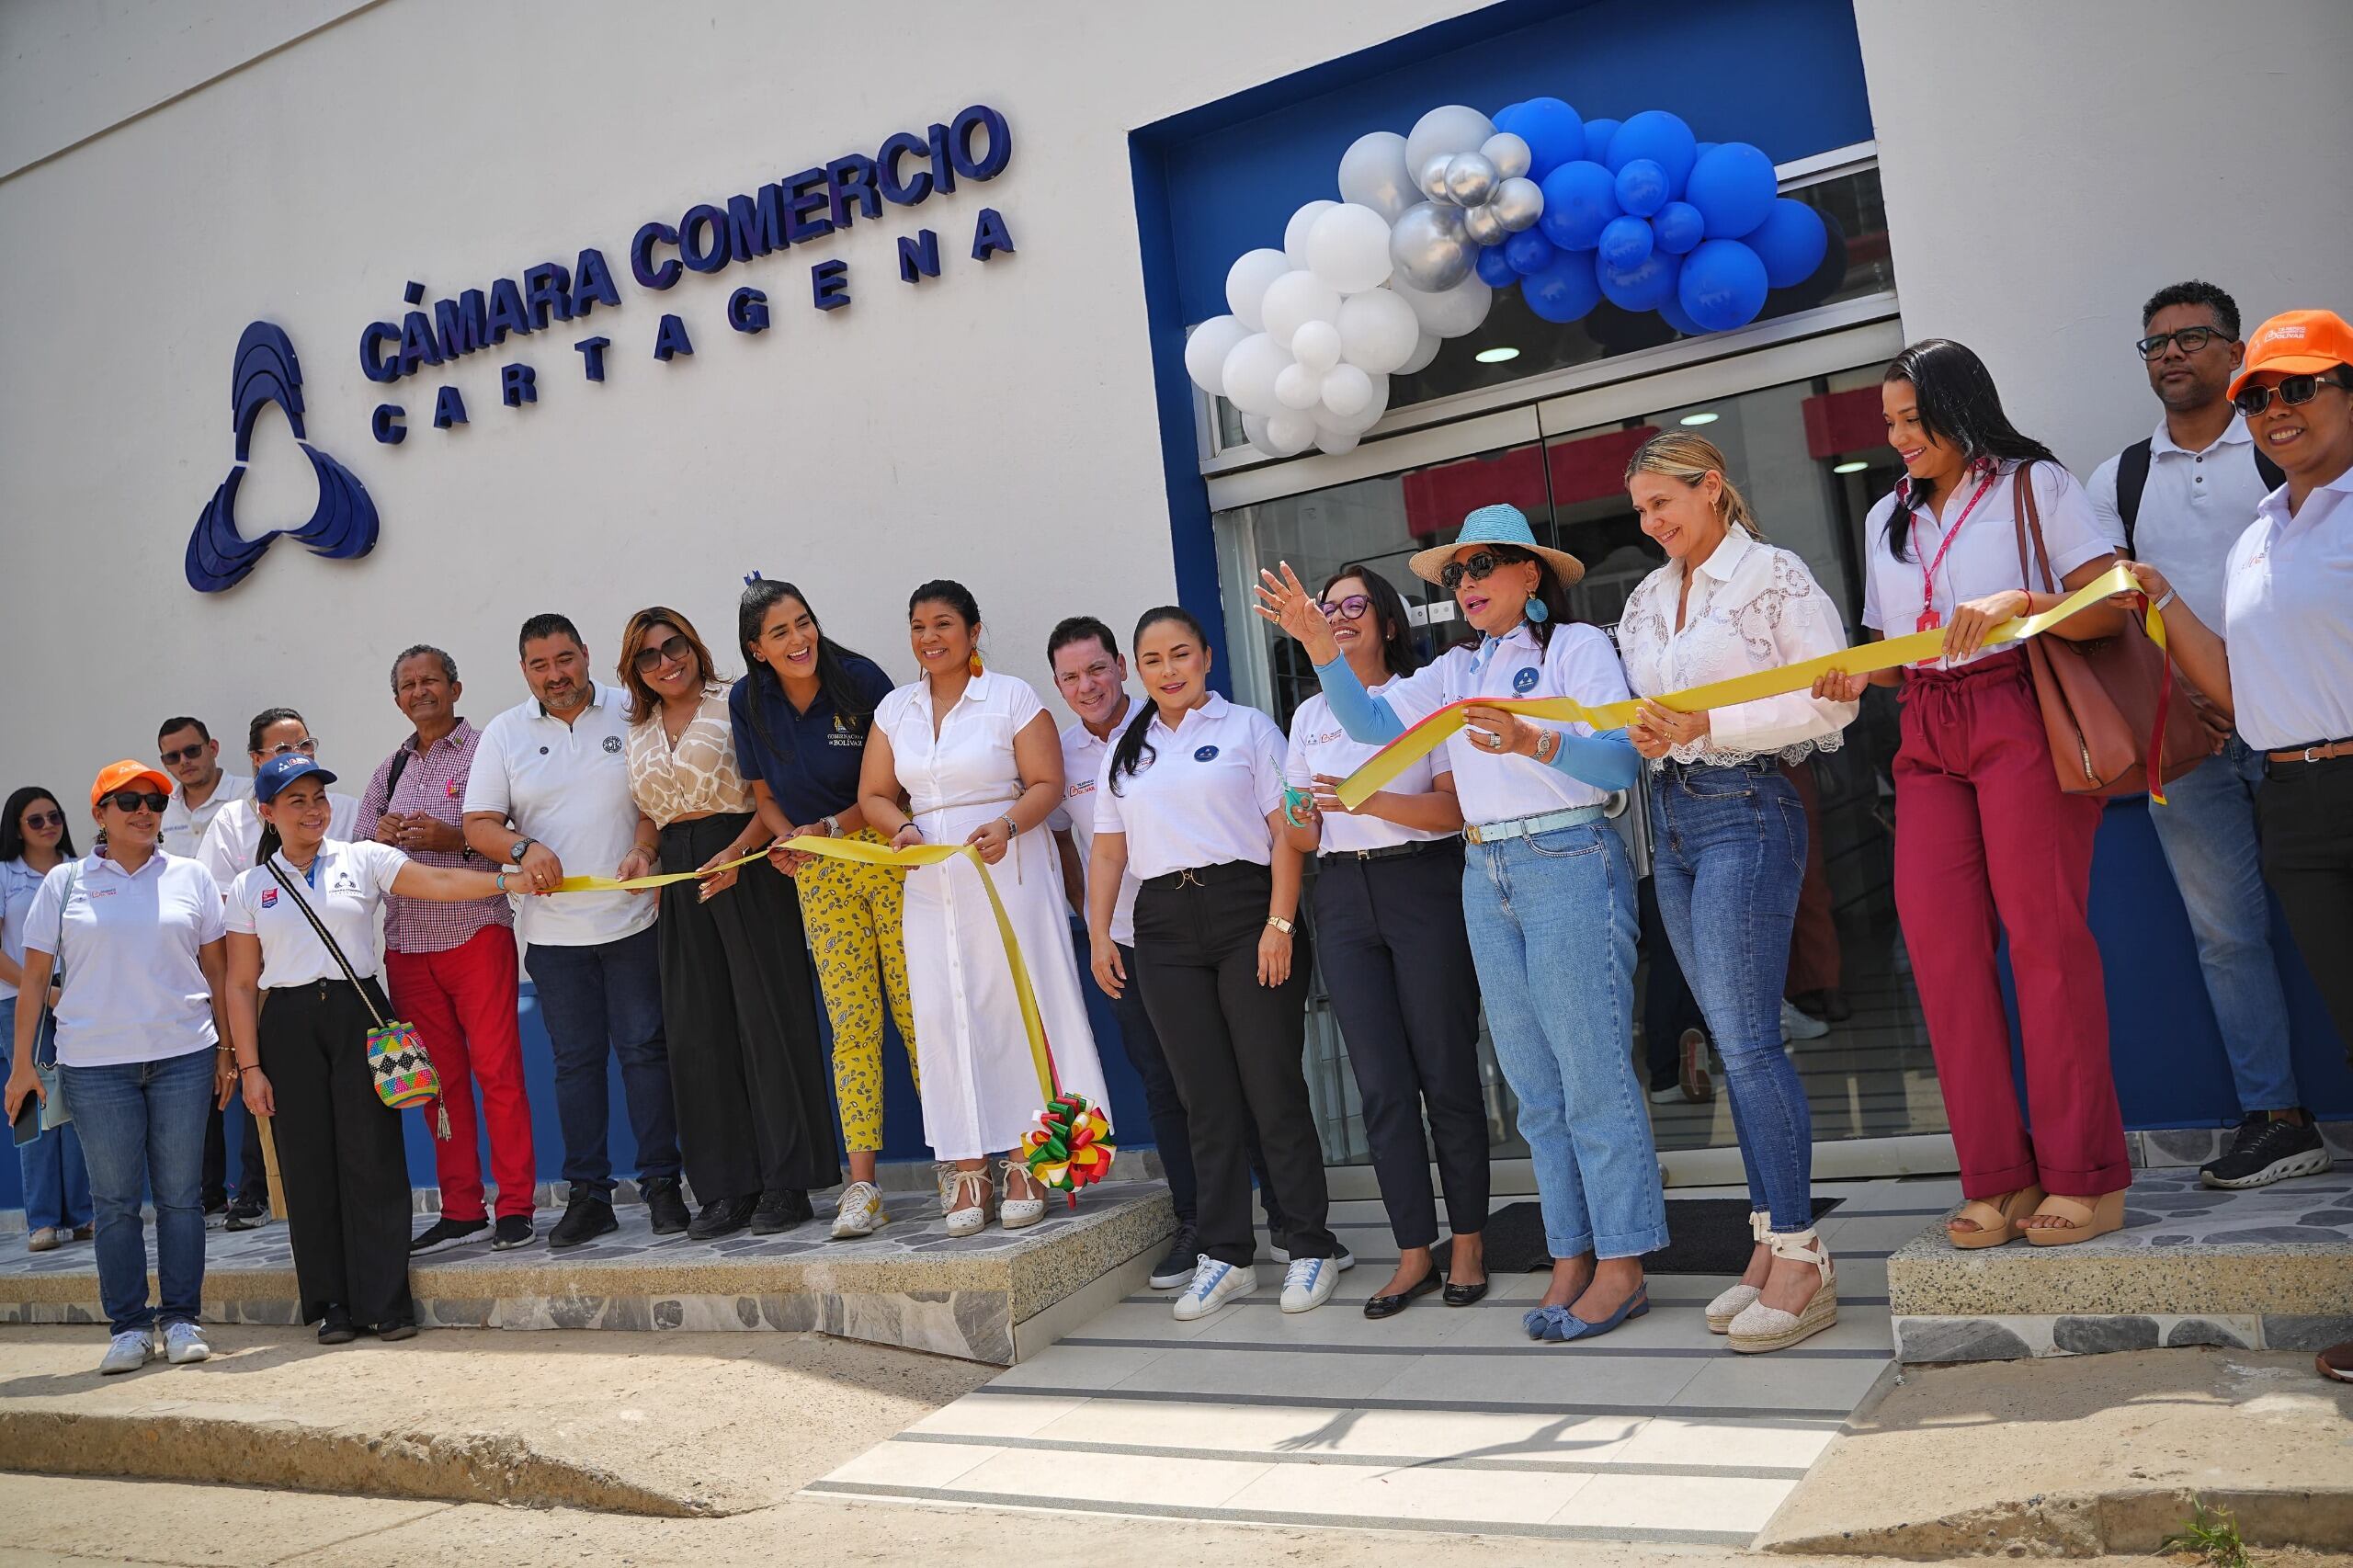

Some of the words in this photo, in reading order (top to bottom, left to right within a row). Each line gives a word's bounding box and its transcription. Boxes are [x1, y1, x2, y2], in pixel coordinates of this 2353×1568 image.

[359, 247, 622, 383] CÁMARA
[631, 104, 1013, 290] COMERCIO
[371, 208, 1015, 445] CARTAGENA
